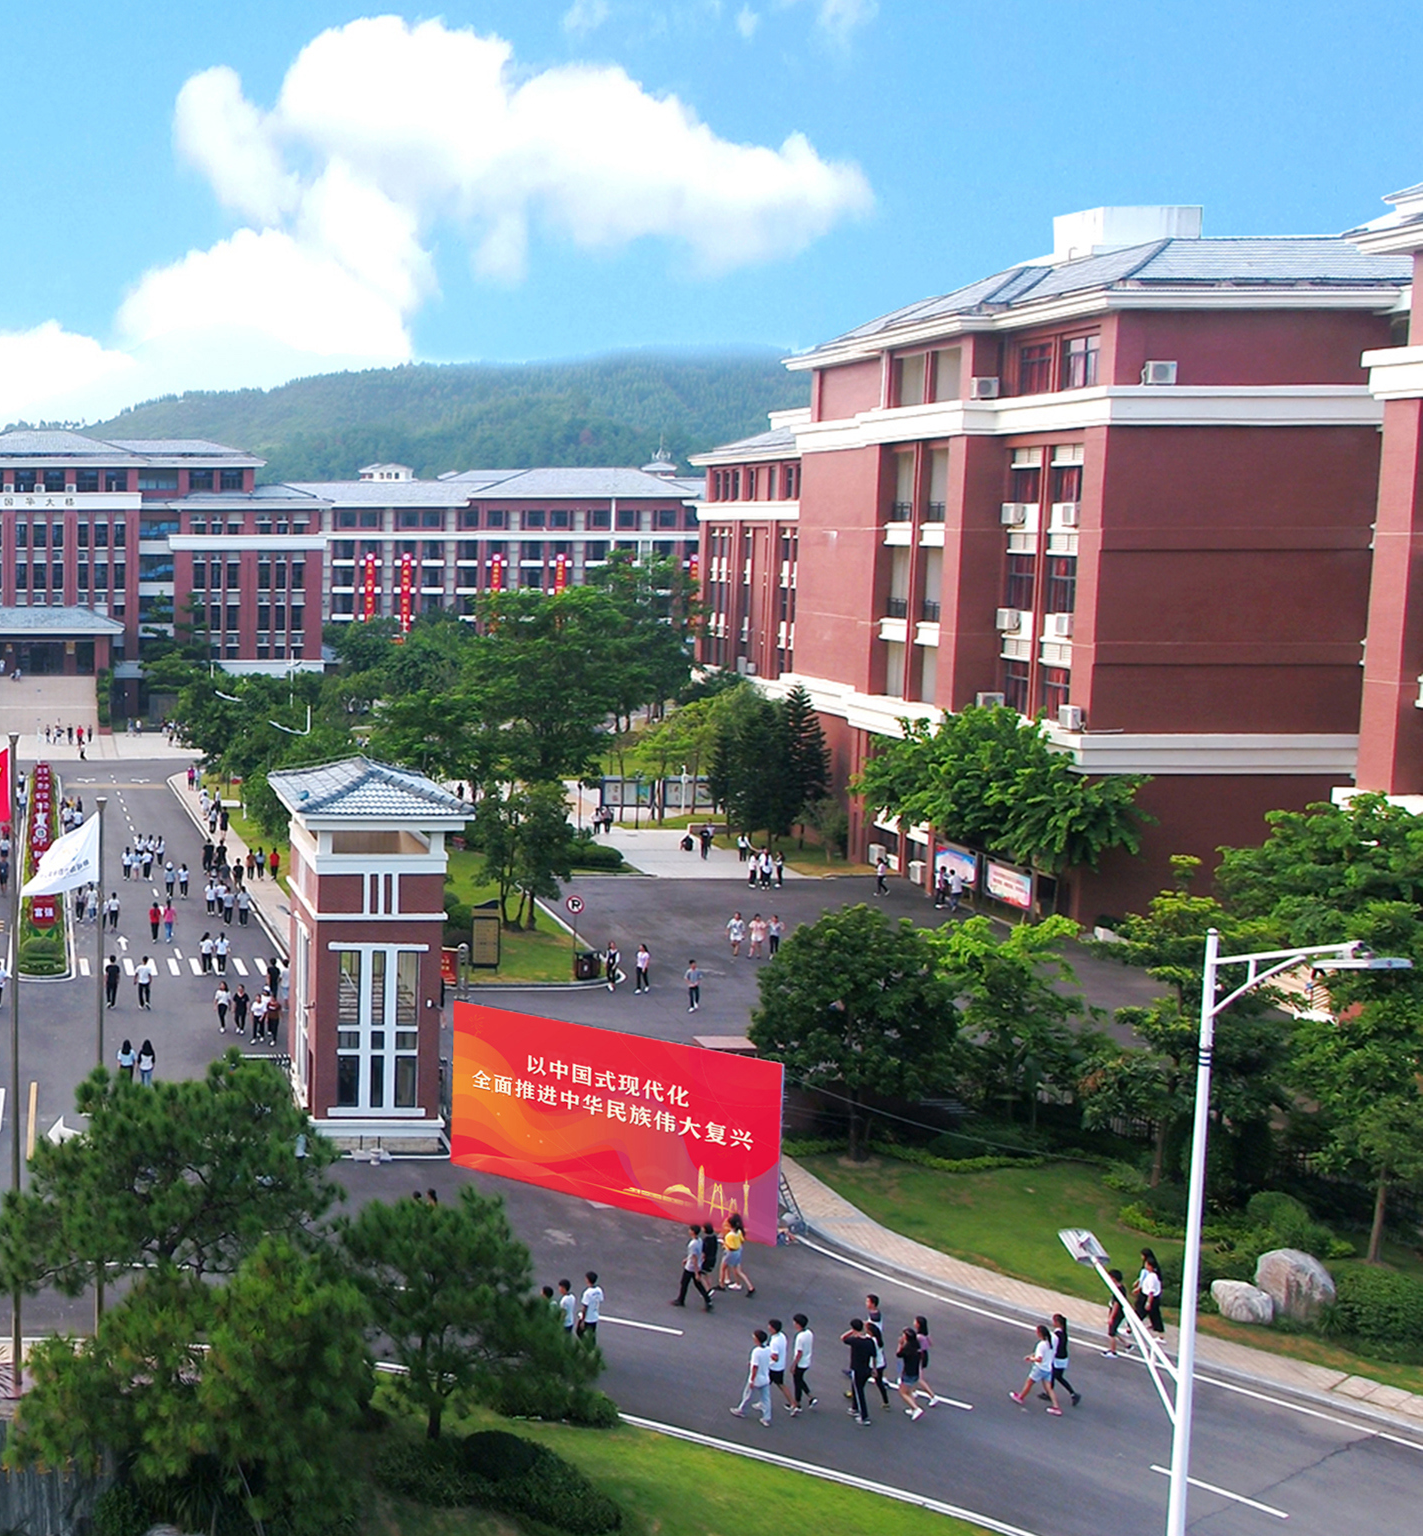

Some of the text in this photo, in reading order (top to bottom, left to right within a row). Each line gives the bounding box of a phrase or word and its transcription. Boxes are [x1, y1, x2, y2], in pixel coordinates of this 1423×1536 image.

[471, 1070, 754, 1151] 全面推进中华民族伟大复兴
[526, 1054, 690, 1108] 以中国式现代化
